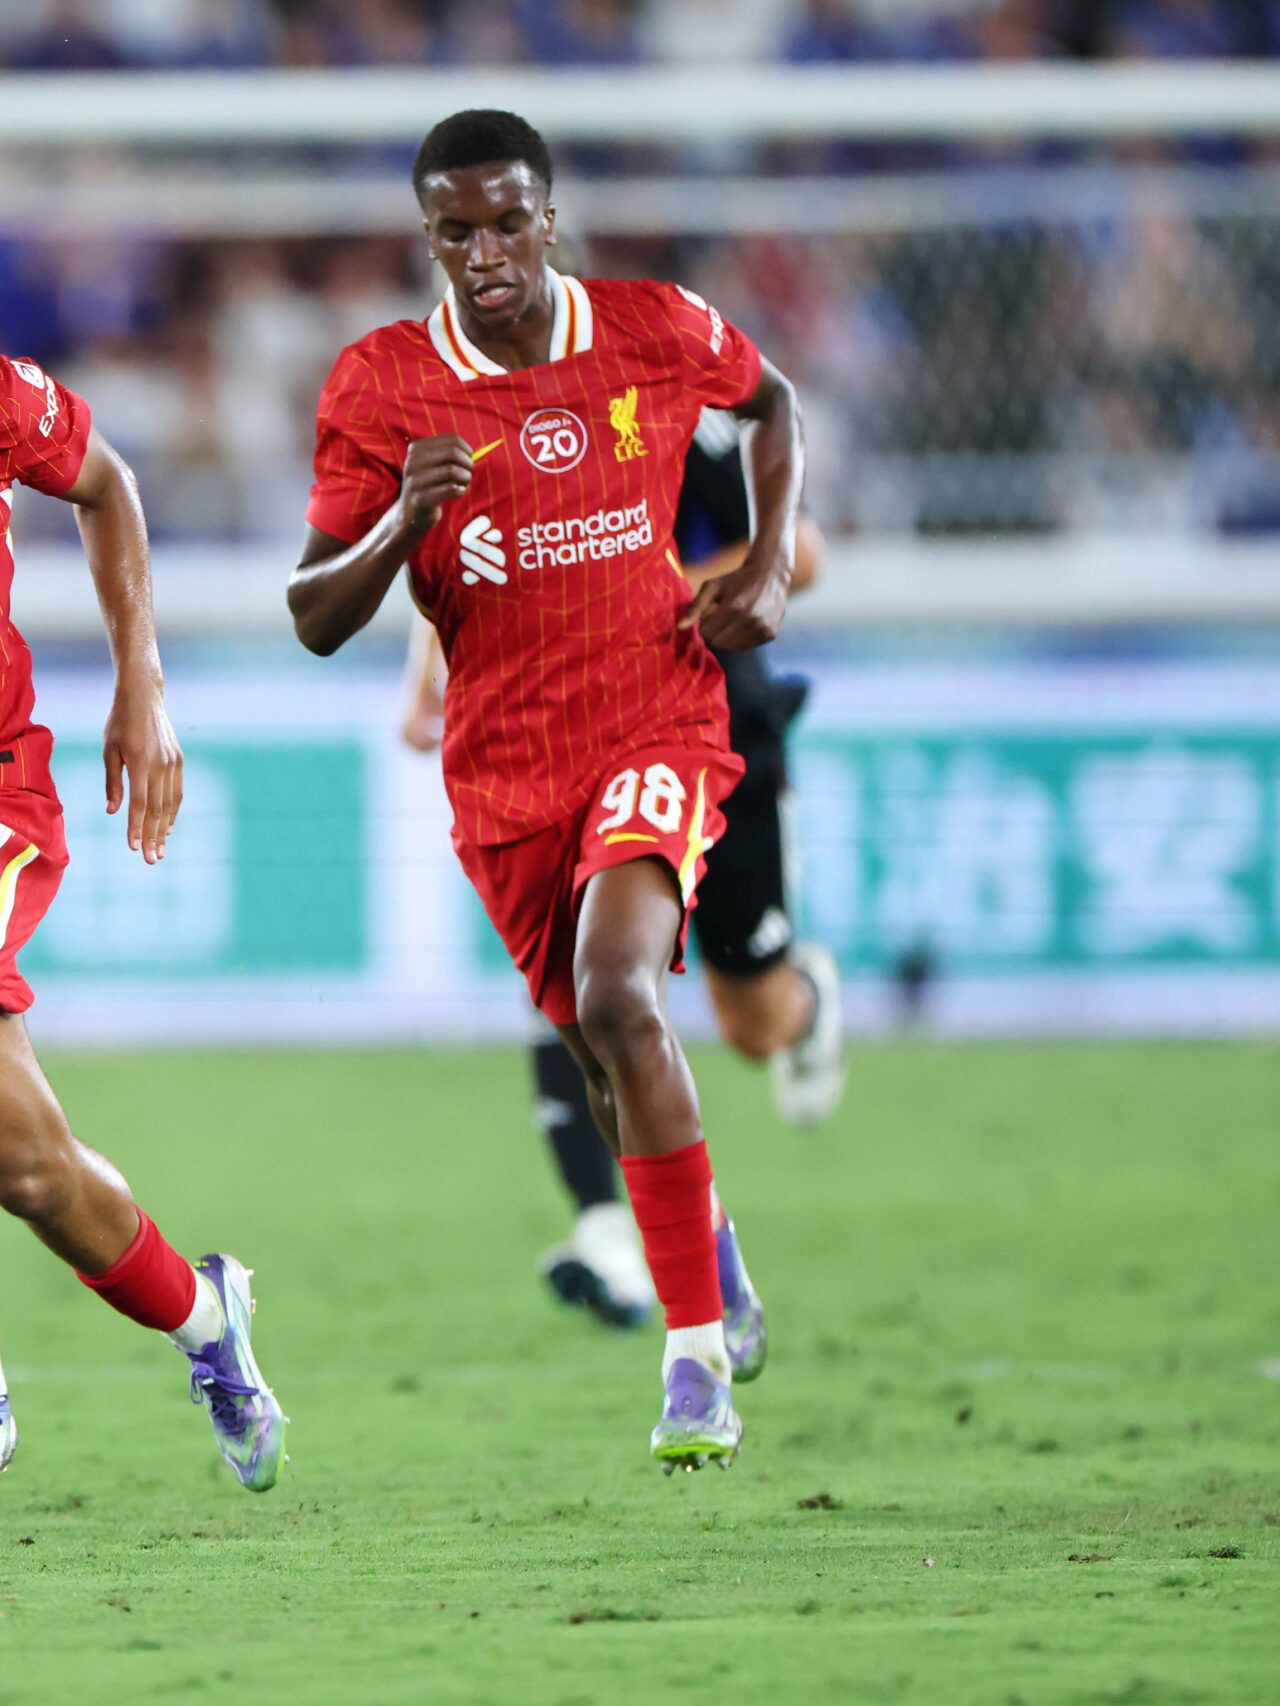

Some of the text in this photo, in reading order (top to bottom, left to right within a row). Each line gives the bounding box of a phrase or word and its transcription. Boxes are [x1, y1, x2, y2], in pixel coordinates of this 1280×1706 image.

[530, 429, 578, 462] 20
[517, 498, 647, 547] standard
[519, 519, 653, 570] chartered
[596, 763, 687, 834] 98
